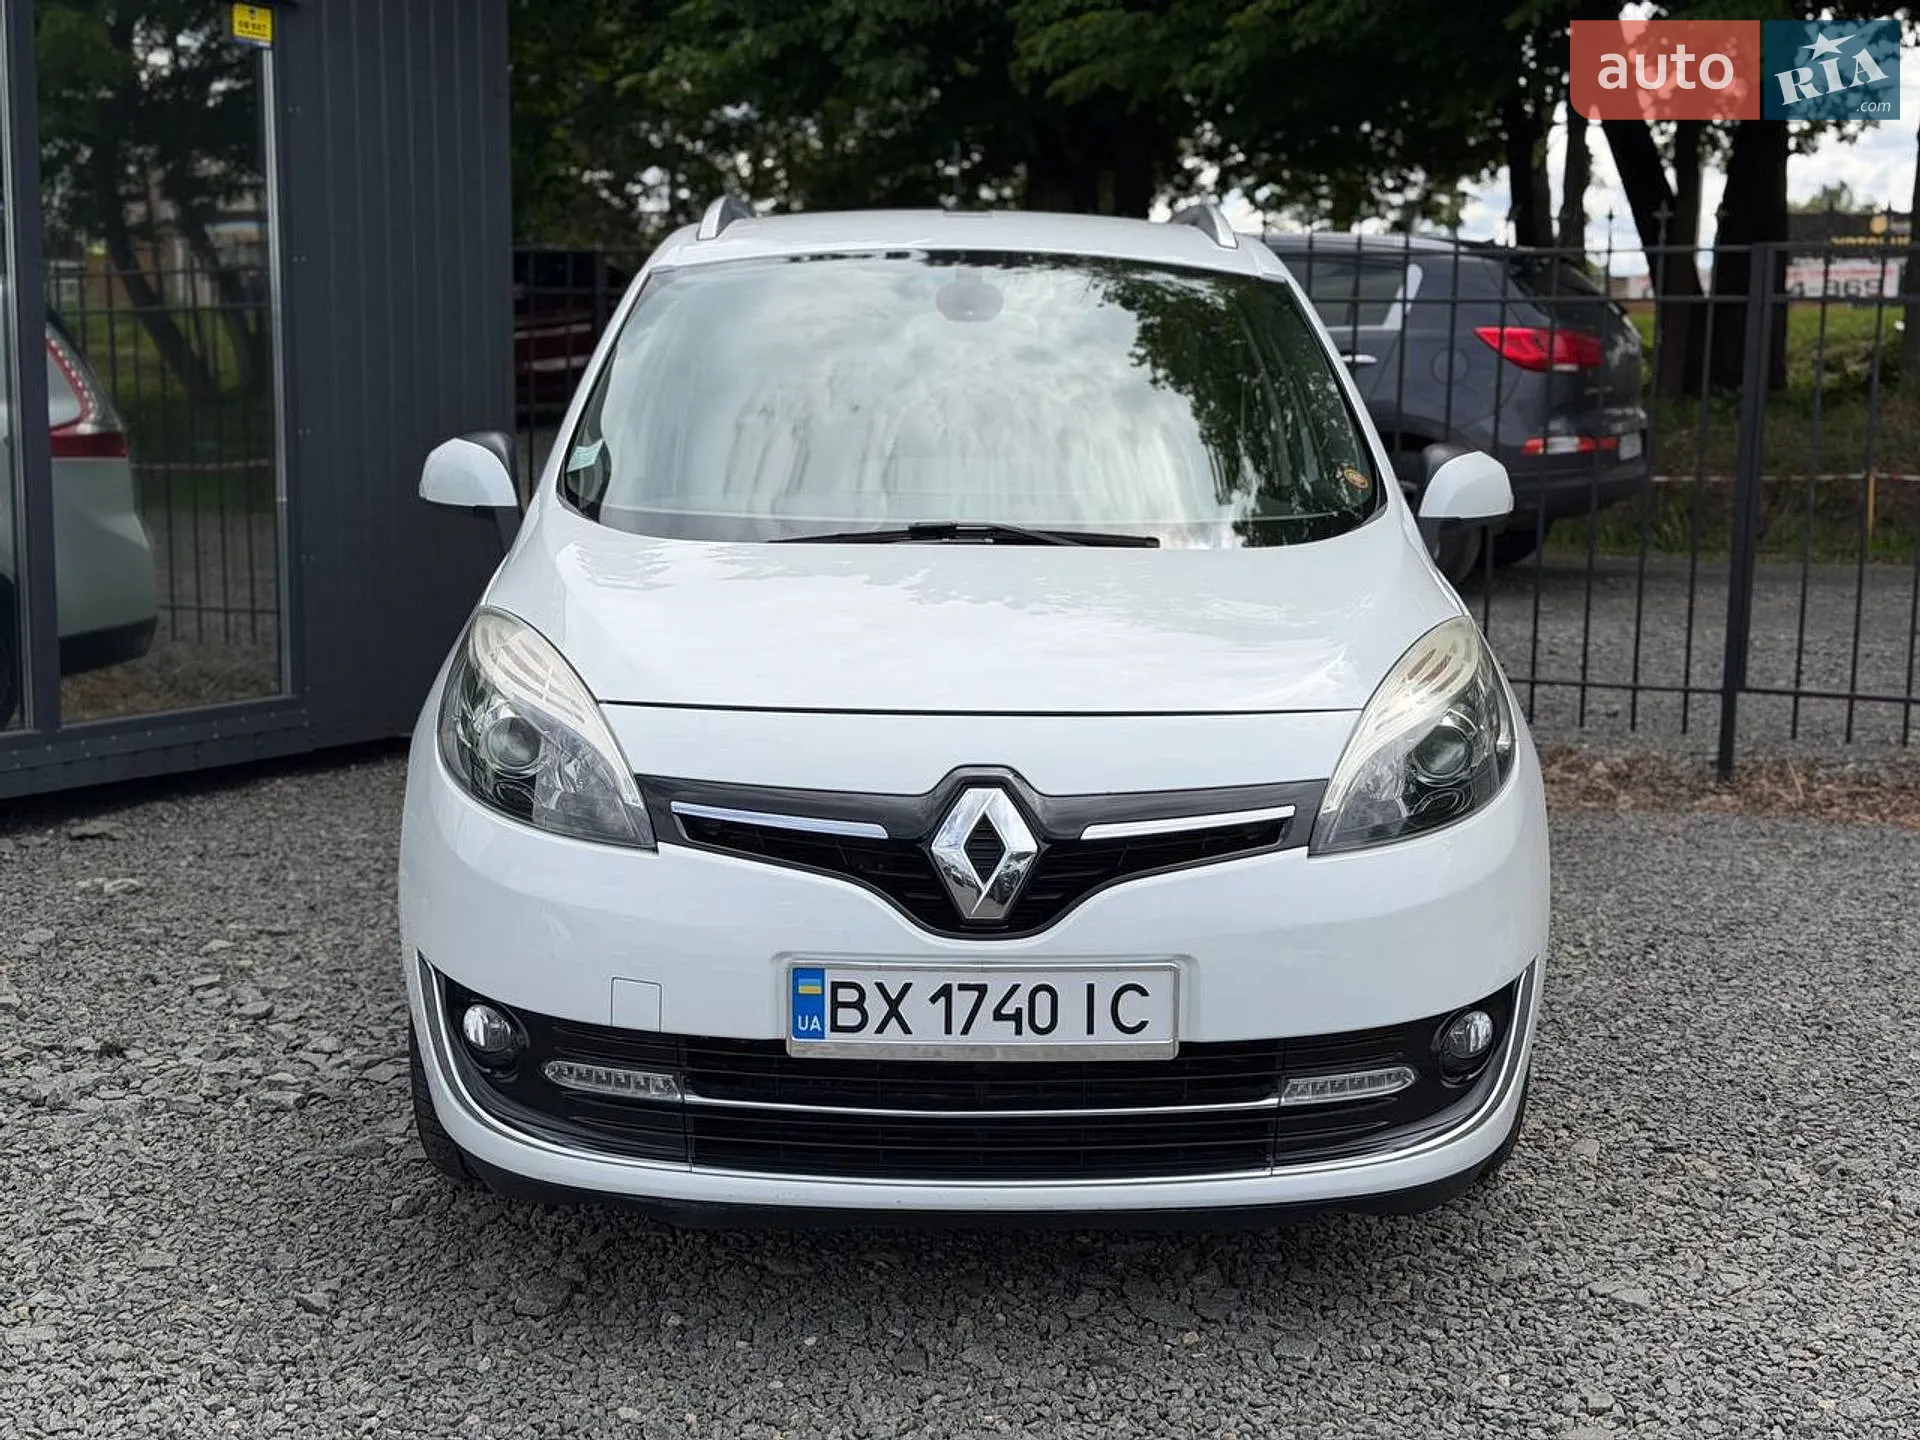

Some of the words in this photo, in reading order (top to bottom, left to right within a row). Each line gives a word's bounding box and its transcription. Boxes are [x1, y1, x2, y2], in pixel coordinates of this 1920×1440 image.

[797, 1015, 822, 1032] UA
[829, 981, 913, 1034] BX
[929, 983, 1059, 1036] 1740
[1085, 983, 1150, 1035] IC
